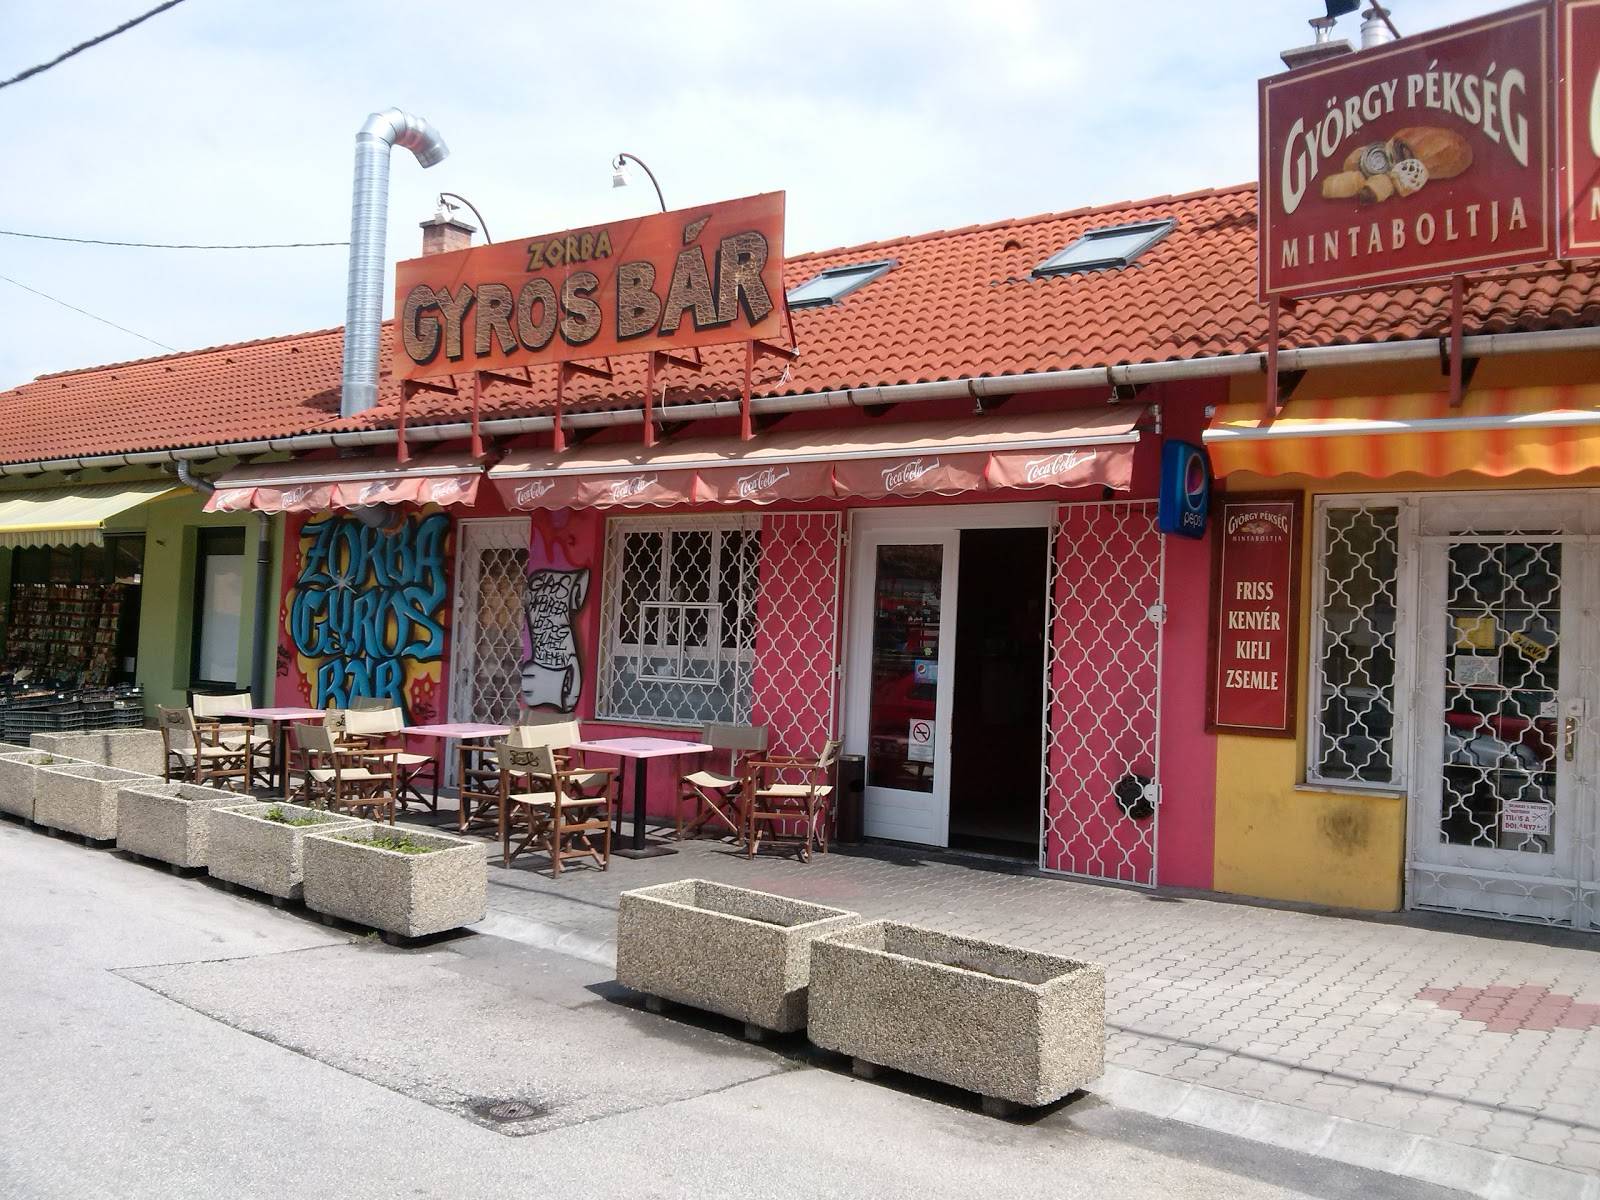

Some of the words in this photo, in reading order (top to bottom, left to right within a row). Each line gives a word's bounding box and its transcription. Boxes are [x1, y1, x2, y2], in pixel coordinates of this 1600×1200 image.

[1282, 78, 1398, 215] GYÖRGY
[1407, 59, 1529, 168] PÉKSÉG
[527, 231, 614, 272] ZORBA
[1281, 197, 1528, 269] MINTABOLTJA
[403, 271, 602, 366] GYROS
[616, 215, 774, 342] BÁR
[1236, 581, 1274, 601] FRISS
[291, 583, 447, 661] GYROS
[1228, 605, 1281, 631] KENYÉR
[1236, 640, 1271, 660] KIFLI
[1225, 669, 1279, 690] ZSEMLE
